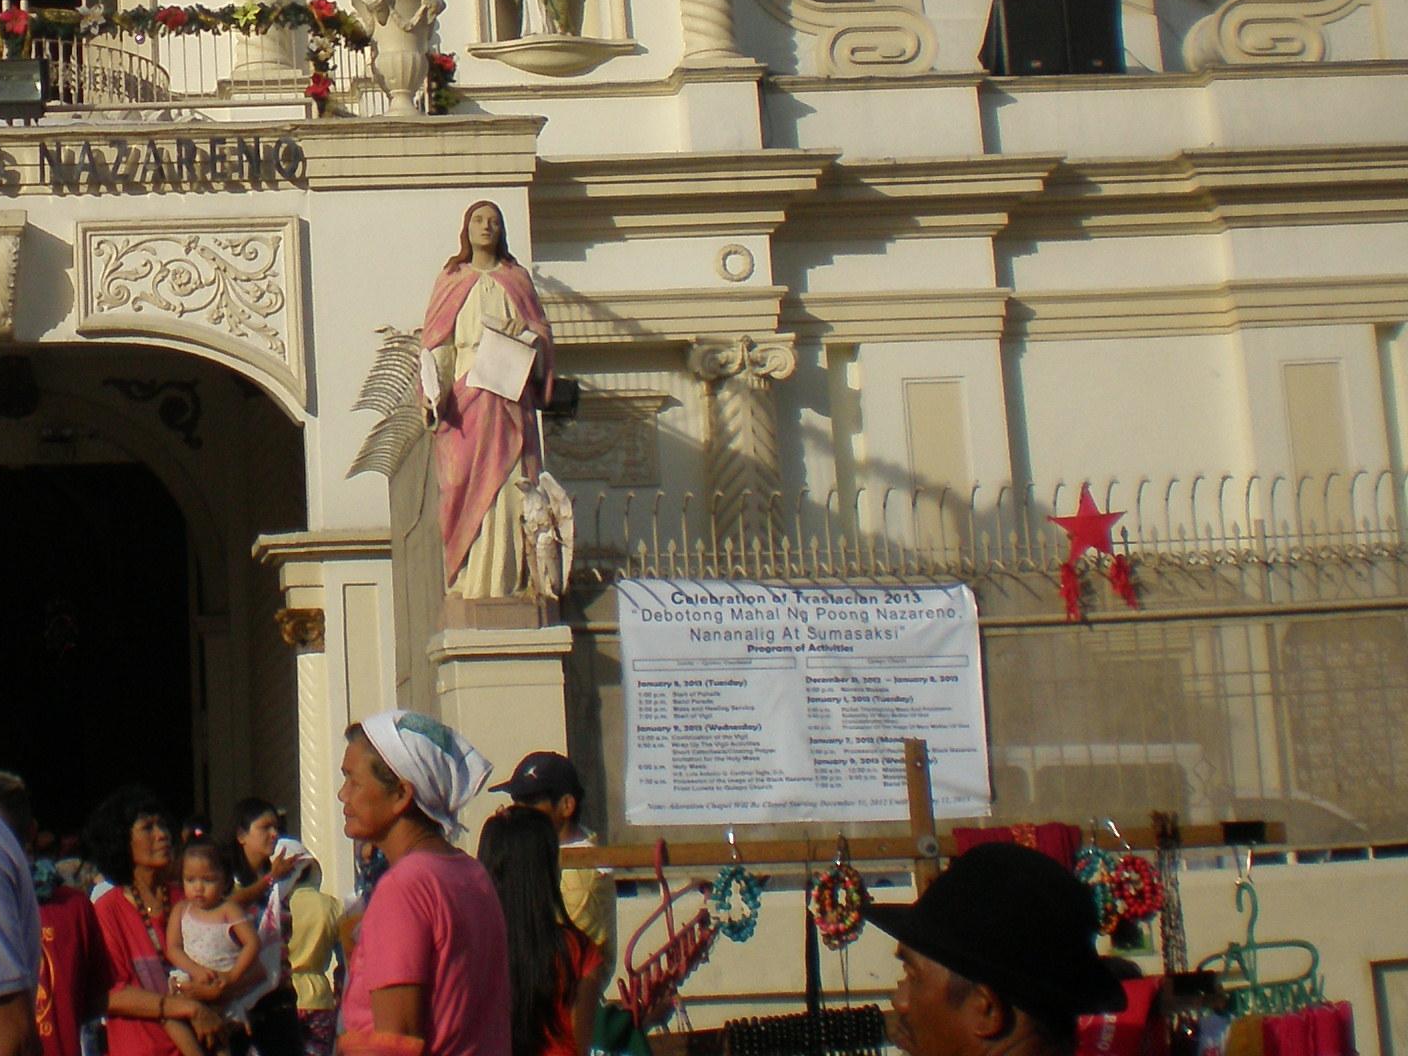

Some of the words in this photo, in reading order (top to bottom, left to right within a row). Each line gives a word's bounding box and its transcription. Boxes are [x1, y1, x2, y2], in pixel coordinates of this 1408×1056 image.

[39, 137, 303, 184] NAZARENO
[671, 591, 766, 605] Celebration
[772, 592, 787, 604] of
[884, 592, 922, 604] 2013
[731, 607, 780, 621] Mahal
[787, 607, 808, 623] Ng
[816, 607, 869, 623] Poong
[690, 628, 775, 643] Nananalig
[782, 627, 800, 640] At
[747, 644, 792, 653] Program
[795, 644, 805, 653] of
[808, 643, 854, 653] Activities
[637, 680, 672, 688] January
[637, 724, 671, 733] January
[704, 723, 762, 732] (Wednesday)
